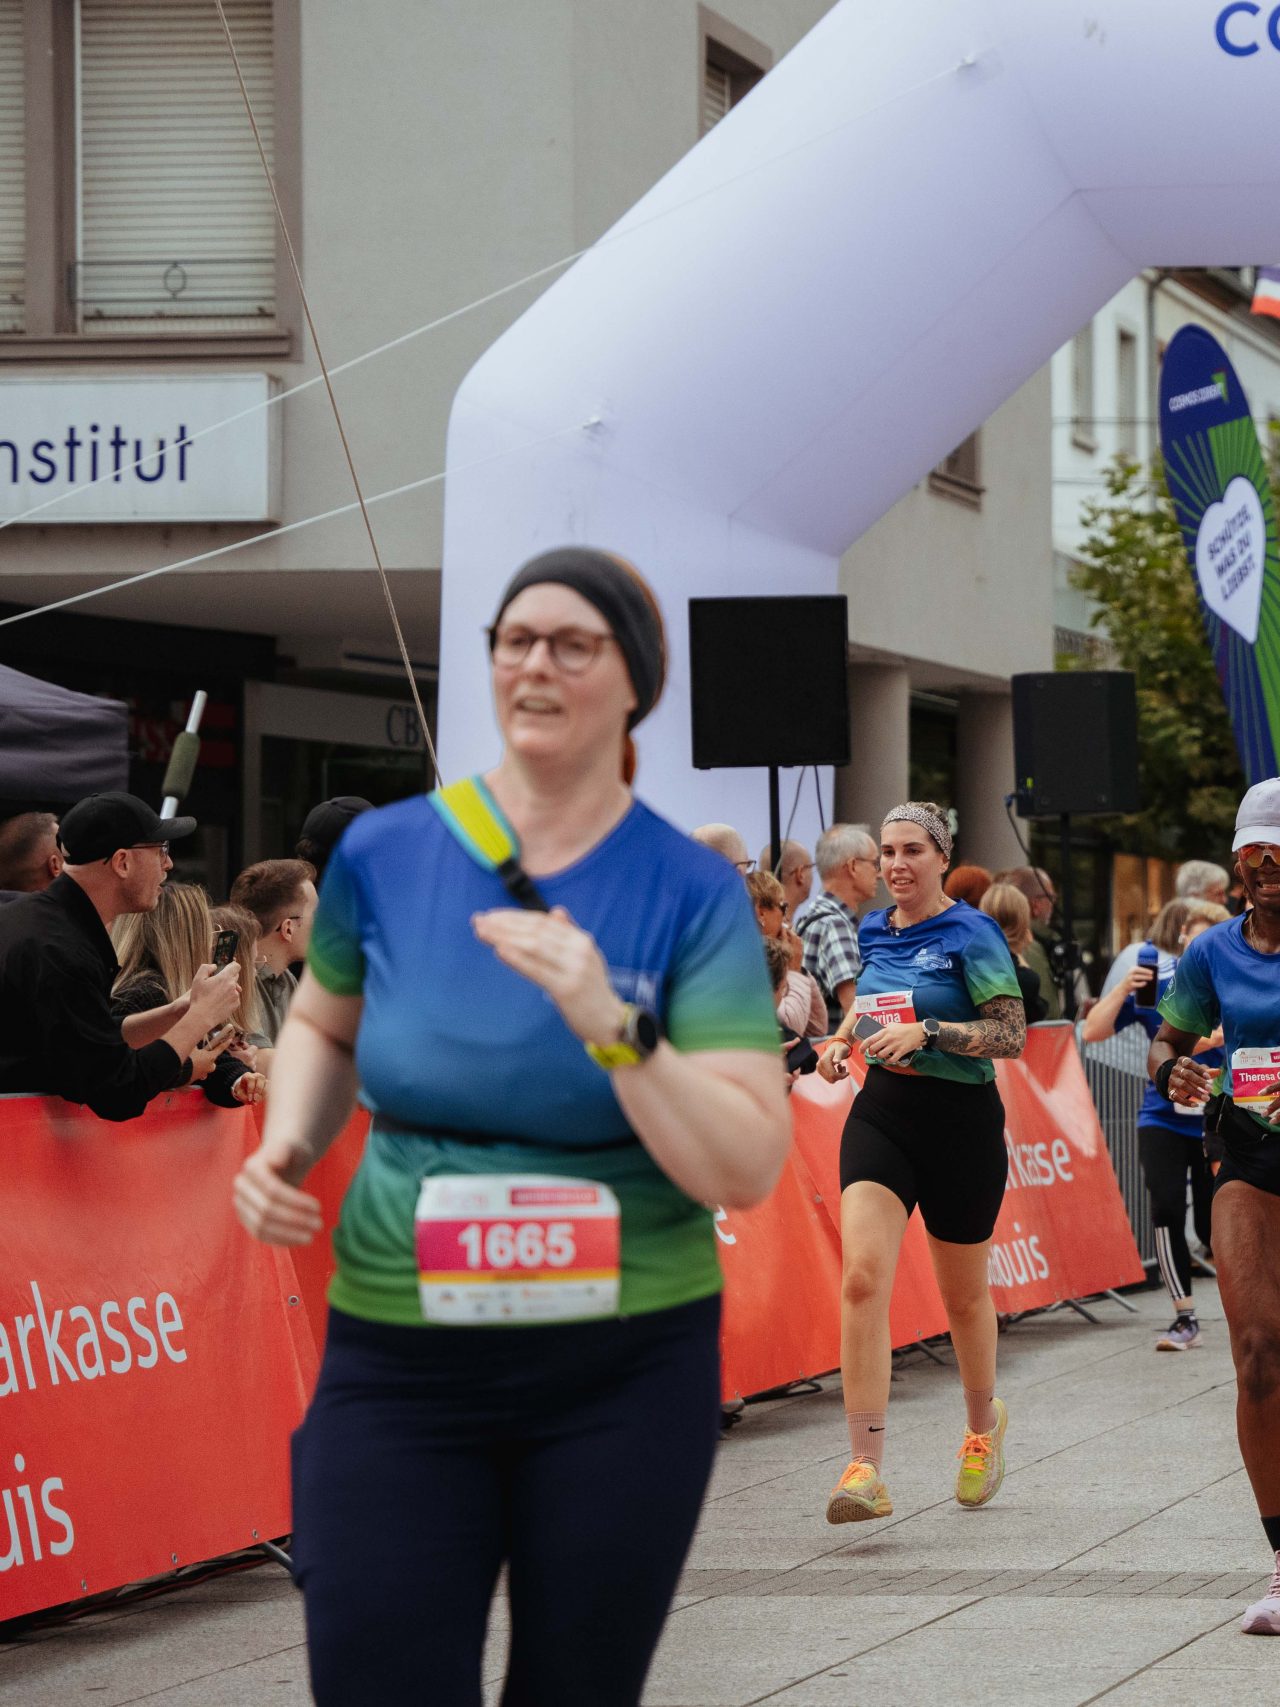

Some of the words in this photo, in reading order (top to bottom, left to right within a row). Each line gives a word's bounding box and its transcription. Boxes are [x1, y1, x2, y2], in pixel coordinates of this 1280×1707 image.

[864, 1011, 901, 1025] arina
[1239, 1071, 1276, 1082] Theresa
[457, 1223, 577, 1269] 1665
